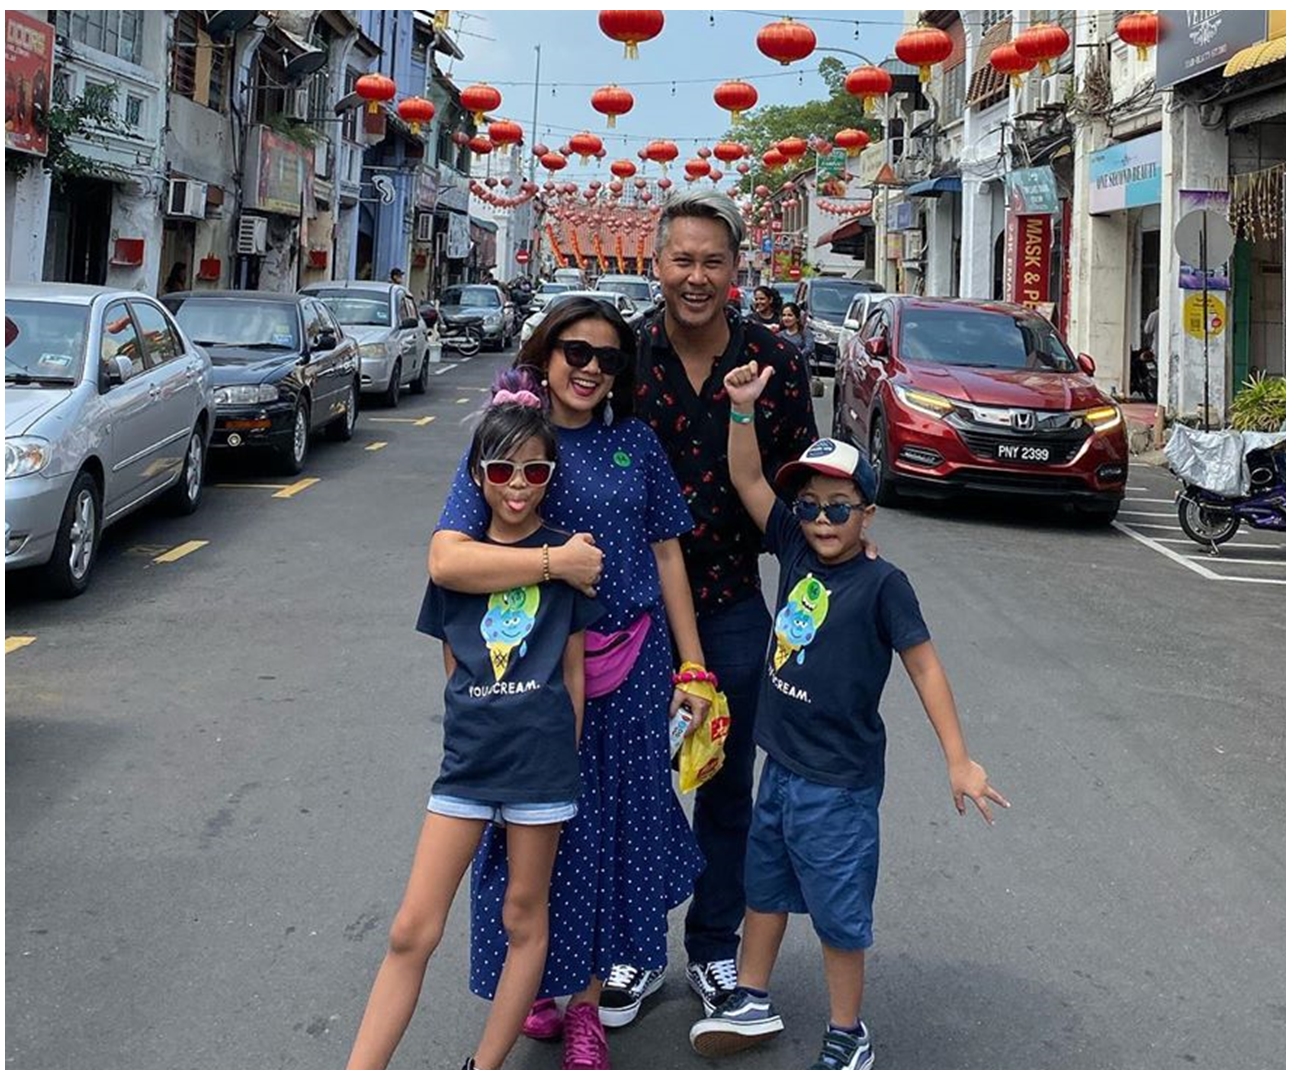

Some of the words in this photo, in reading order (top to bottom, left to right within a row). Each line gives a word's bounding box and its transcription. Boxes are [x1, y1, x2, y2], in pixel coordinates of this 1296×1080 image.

[1025, 219, 1043, 268] MASK
[1023, 271, 1041, 285] &
[998, 445, 1019, 458] PNY
[1021, 446, 1049, 461] 2399
[468, 685, 489, 698] YOU
